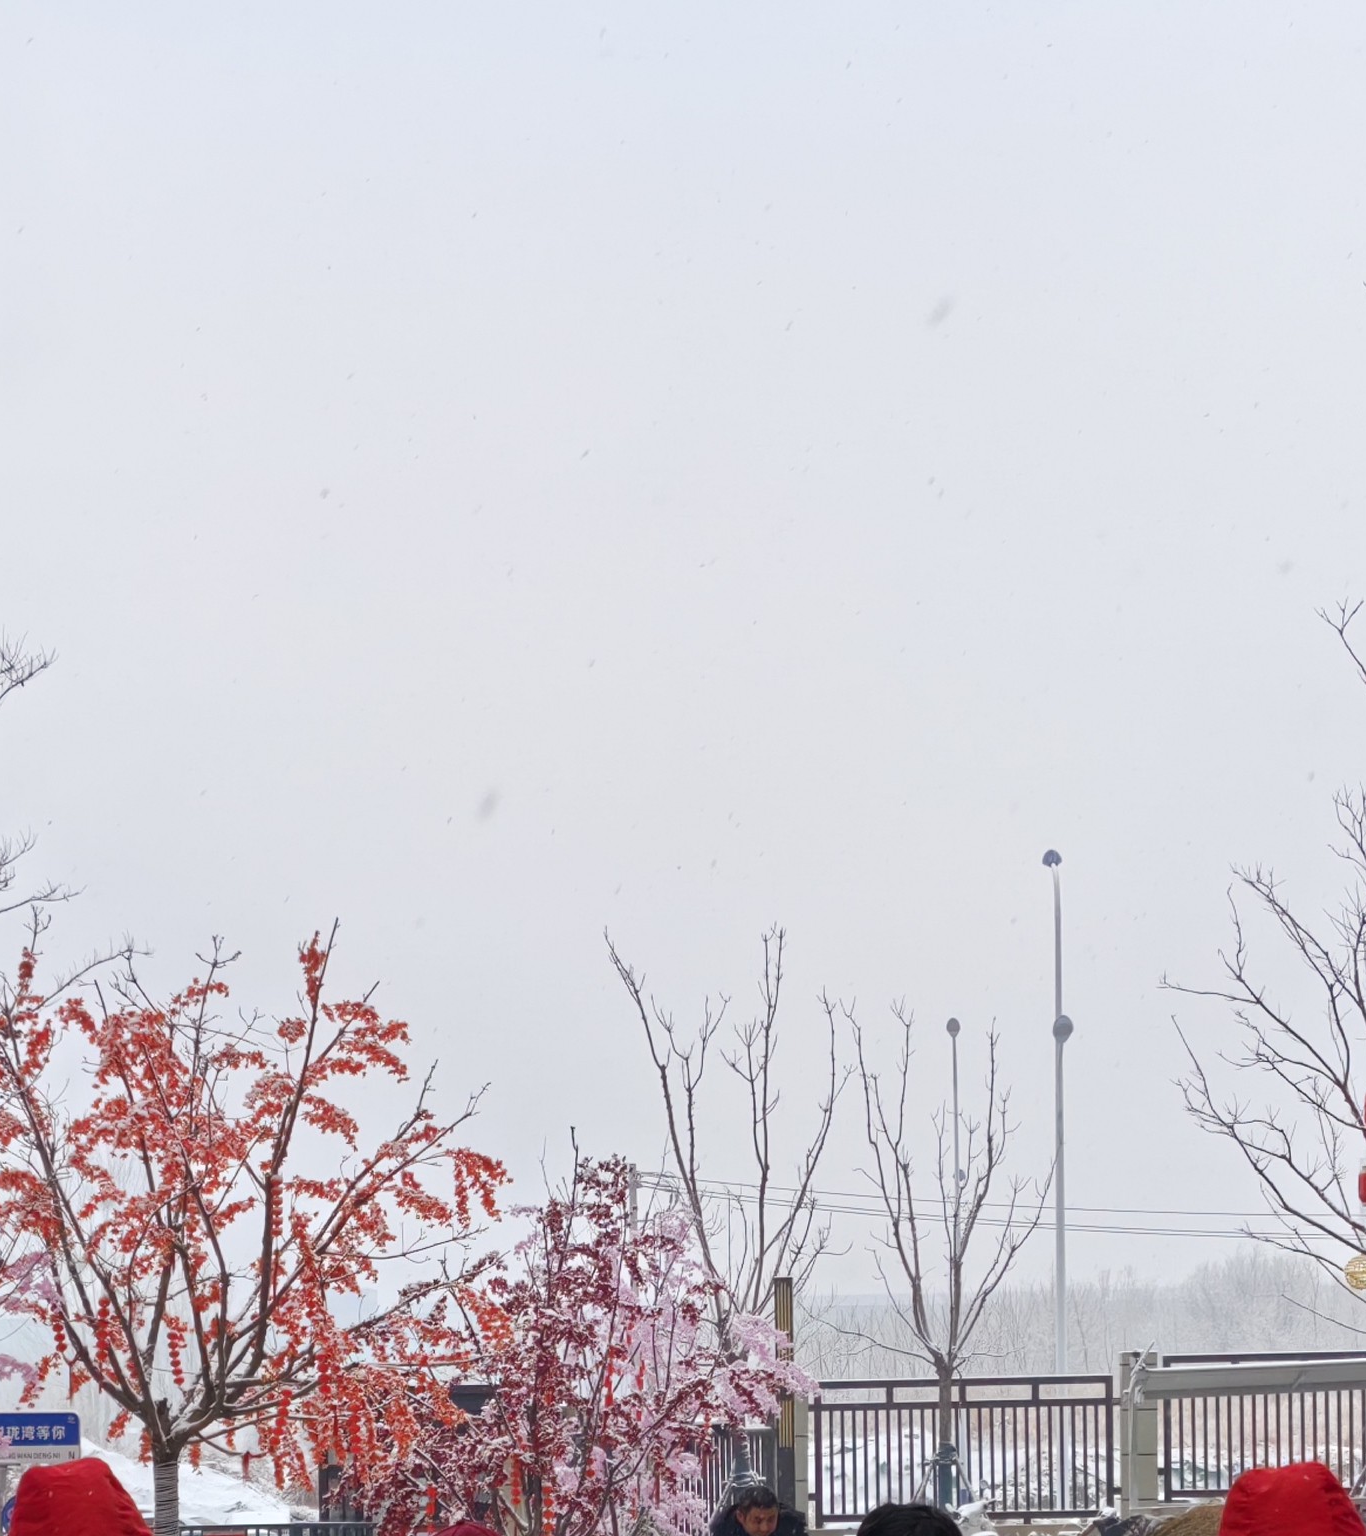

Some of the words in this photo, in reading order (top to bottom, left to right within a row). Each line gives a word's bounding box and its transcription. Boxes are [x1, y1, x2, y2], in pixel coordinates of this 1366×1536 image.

[17, 1452, 33, 1460] WAN
[33, 1452, 52, 1460] DENG
[68, 1451, 75, 1460] N
